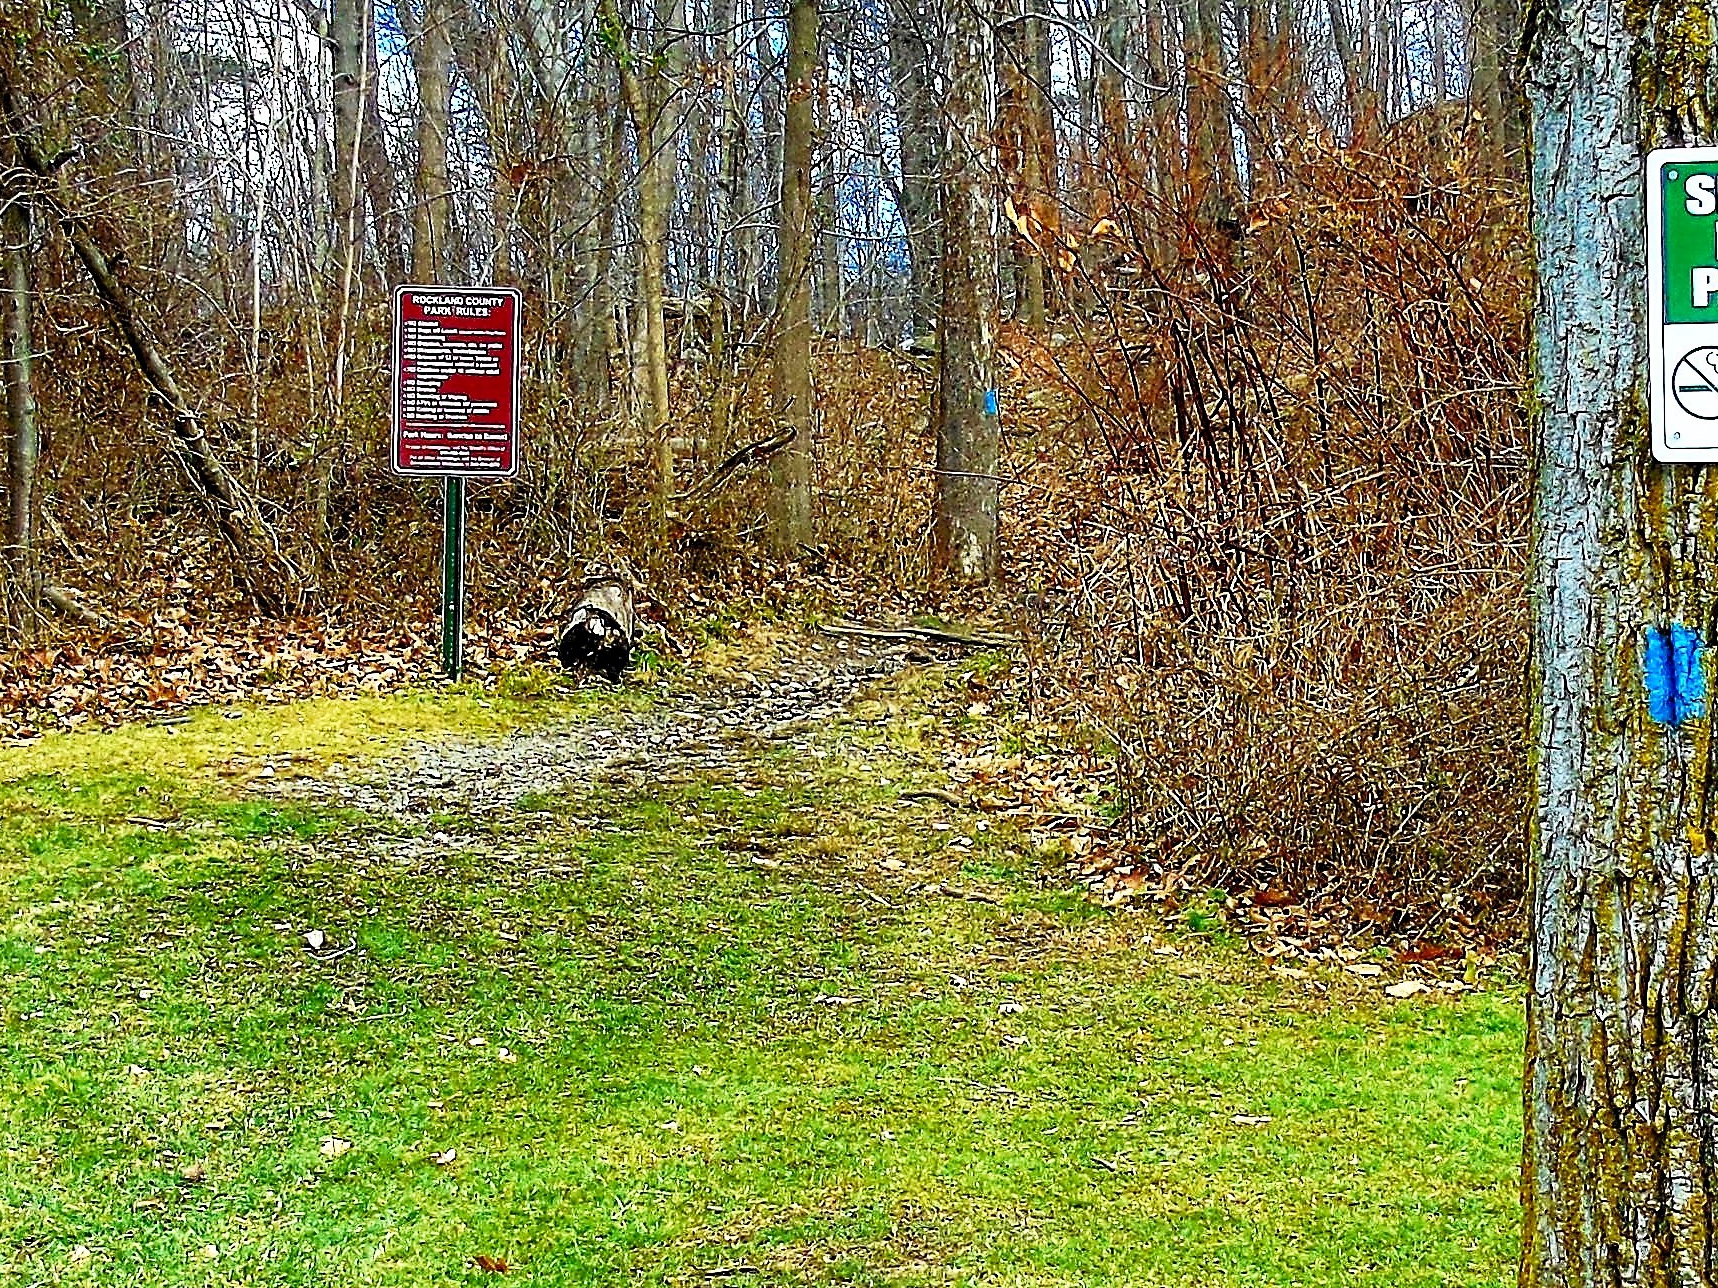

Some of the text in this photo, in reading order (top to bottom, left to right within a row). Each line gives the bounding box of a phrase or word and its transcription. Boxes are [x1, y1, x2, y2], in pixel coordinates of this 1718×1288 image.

[412, 295, 504, 306] ROCKLAND COUNTY
[423, 306, 491, 316] PARK RULES:
